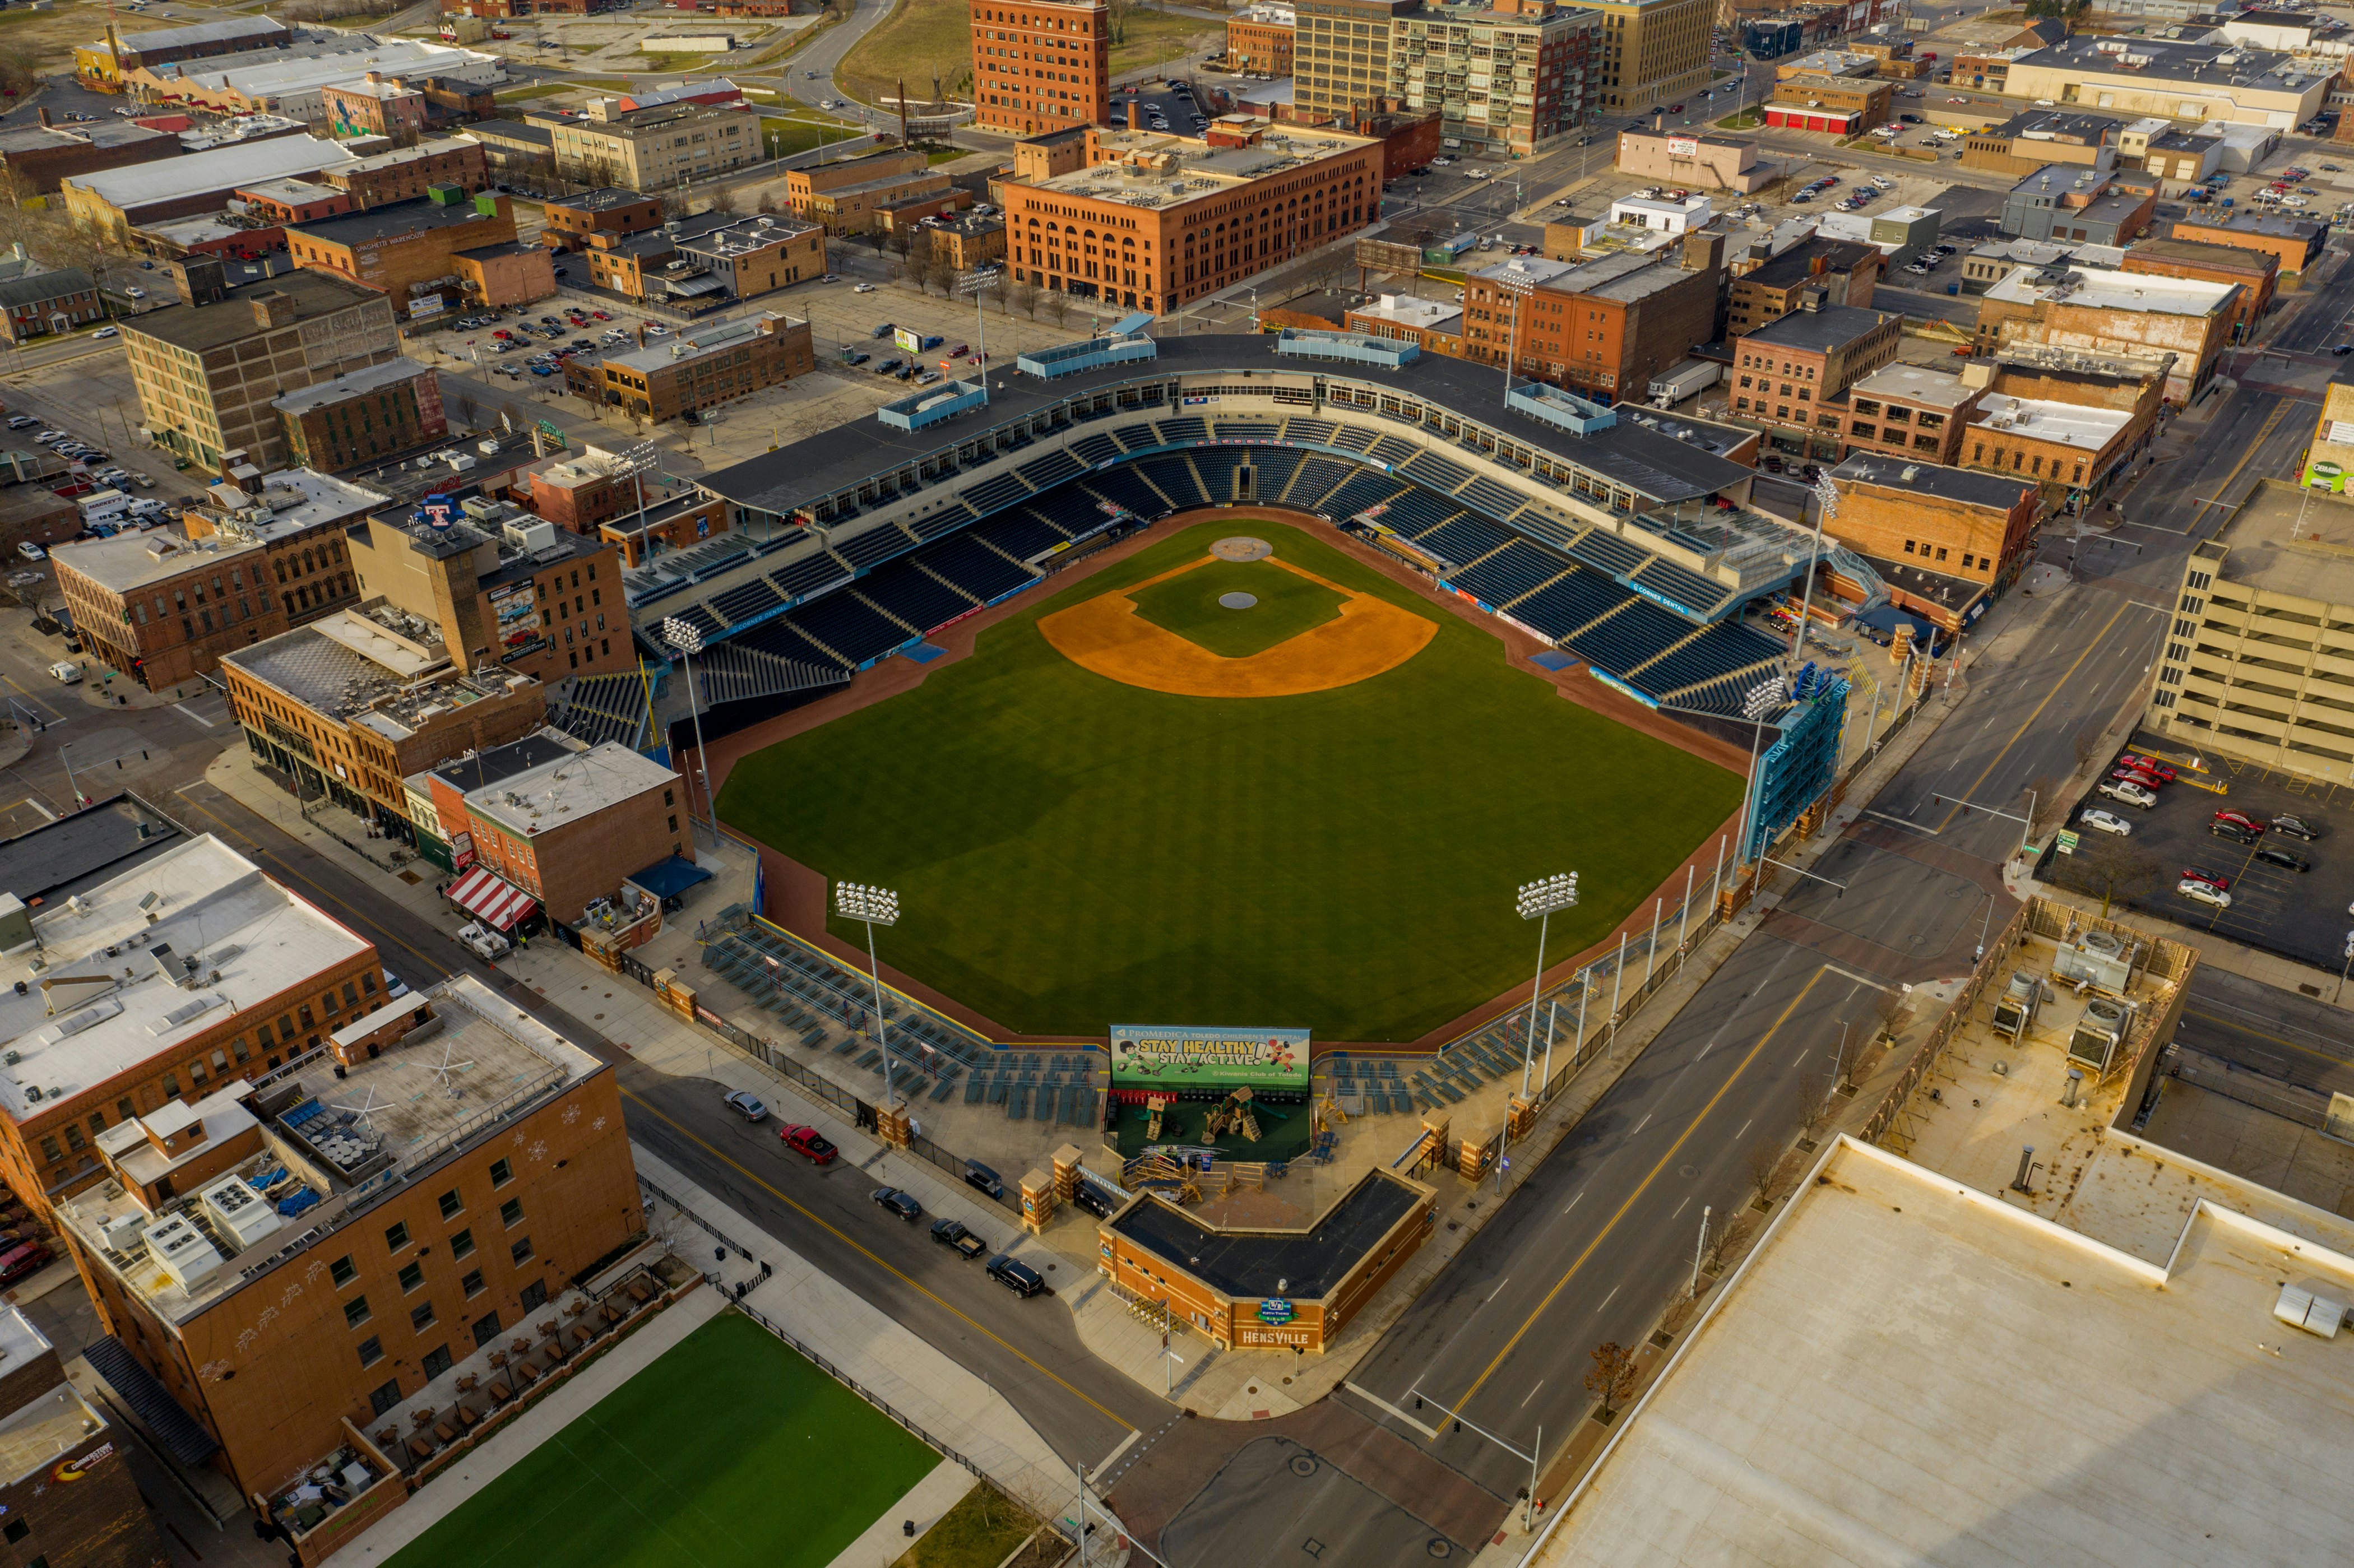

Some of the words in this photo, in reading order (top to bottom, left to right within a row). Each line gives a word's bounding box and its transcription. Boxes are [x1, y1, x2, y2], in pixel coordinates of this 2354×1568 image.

[2201, 89, 2230, 98] morgan
[355, 240, 387, 253] SPAGHETTI
[390, 231, 426, 245] WAREHOUSE
[1781, 421, 1814, 432] PRODUCE
[2313, 464, 2332, 474] OBM
[89, 497, 122, 510] MARKEY'S
[1639, 587, 1661, 602] CORNER
[1663, 597, 1685, 613] DENTAL
[739, 615, 762, 630] CORNER
[764, 605, 787, 619] DENTAL
[503, 642, 545, 663] GLADIATOR
[1139, 1039, 1179, 1053] STAY
[1160, 1052, 1193, 1064] STAY
[1081, 1170, 1093, 1179] 2ND
[1096, 1177, 1112, 1190] BASE
[1115, 1189, 1130, 1200] GATE
[71, 1442, 112, 1471] CORNERSTONE
